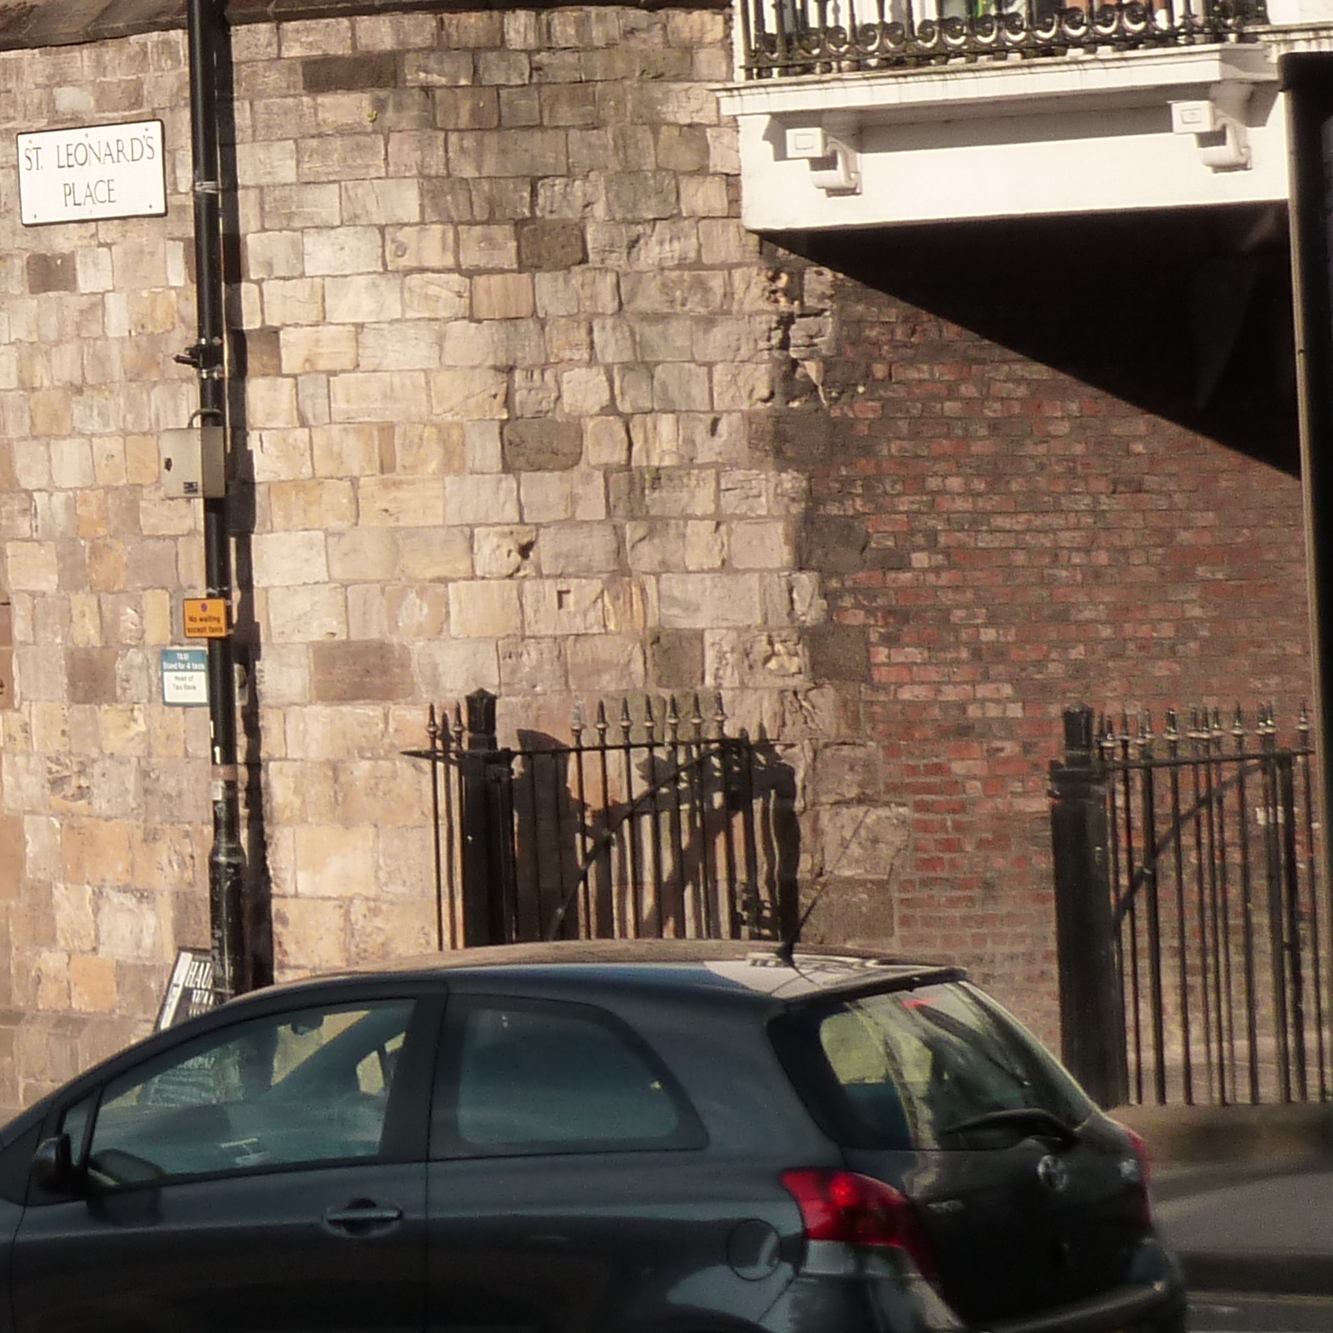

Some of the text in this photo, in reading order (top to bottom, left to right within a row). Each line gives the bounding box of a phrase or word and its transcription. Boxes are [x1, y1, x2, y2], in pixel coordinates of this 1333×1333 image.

[25, 135, 155, 171] ST. LEONARD'S
[63, 179, 116, 207] PLACE
